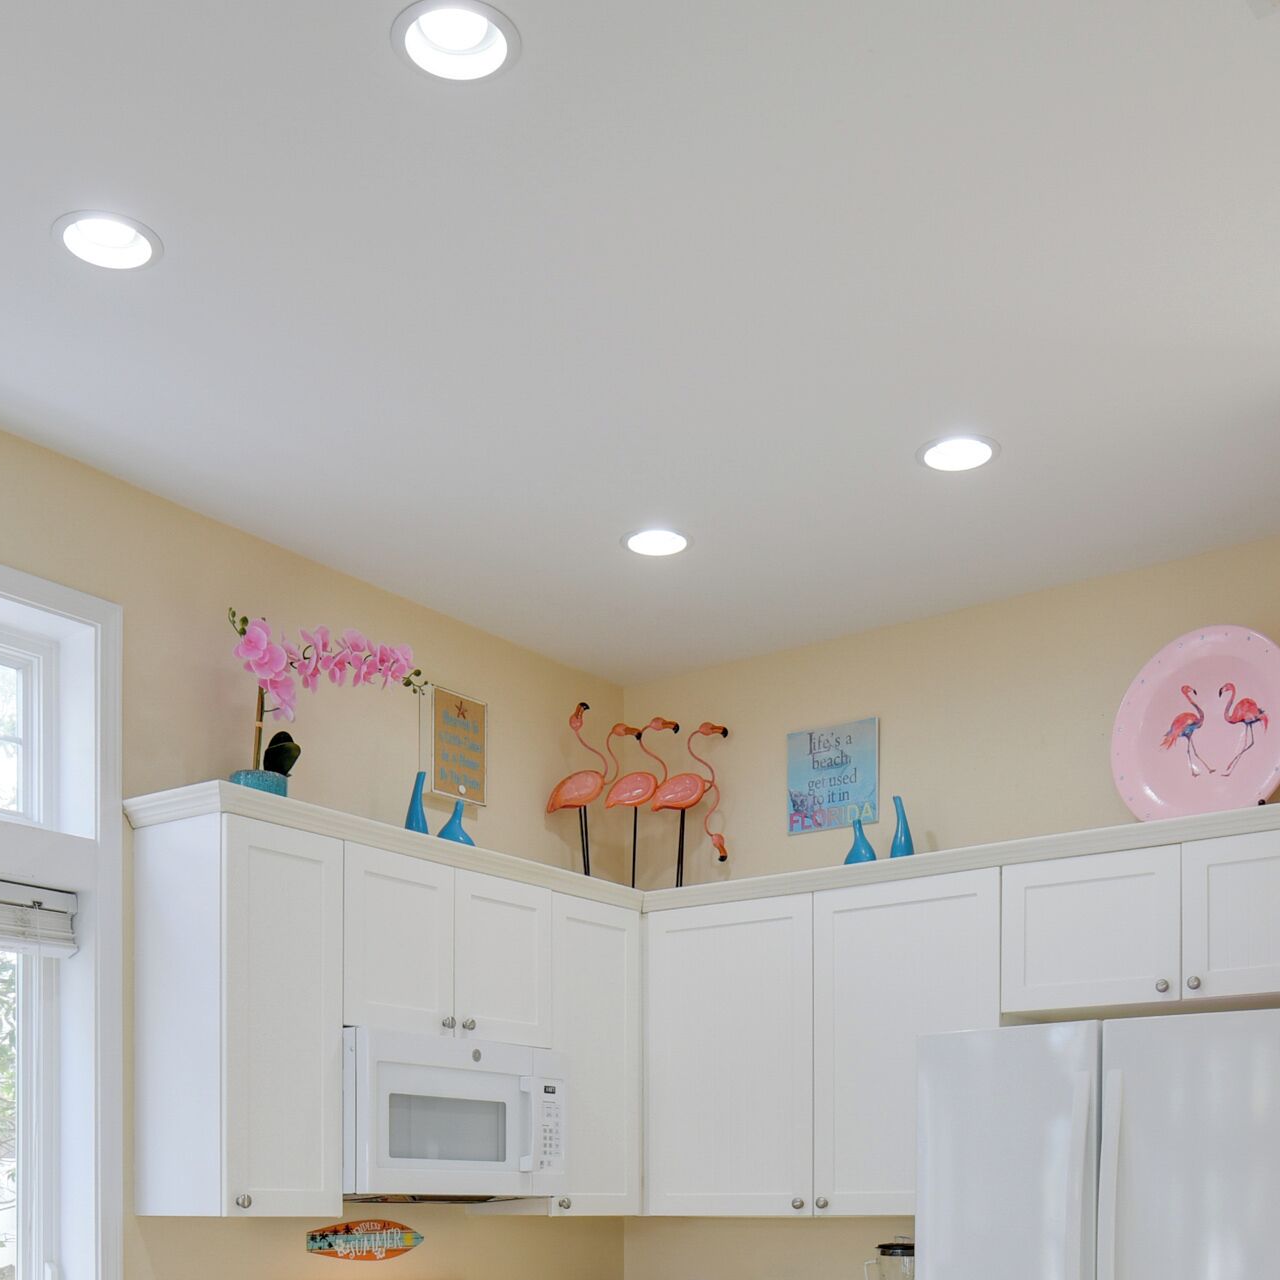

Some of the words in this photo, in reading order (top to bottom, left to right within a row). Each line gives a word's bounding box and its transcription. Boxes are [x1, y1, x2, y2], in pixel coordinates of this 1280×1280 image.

[808, 732, 841, 755] Life's
[845, 734, 852, 745] a
[808, 777, 825, 796] get
[828, 767, 857, 787] used
[813, 794, 824, 806] to
[828, 790, 836, 804] it
[838, 789, 850, 802] in
[789, 801, 874, 832] FLORIDA
[350, 1227, 402, 1260] SUMMER
